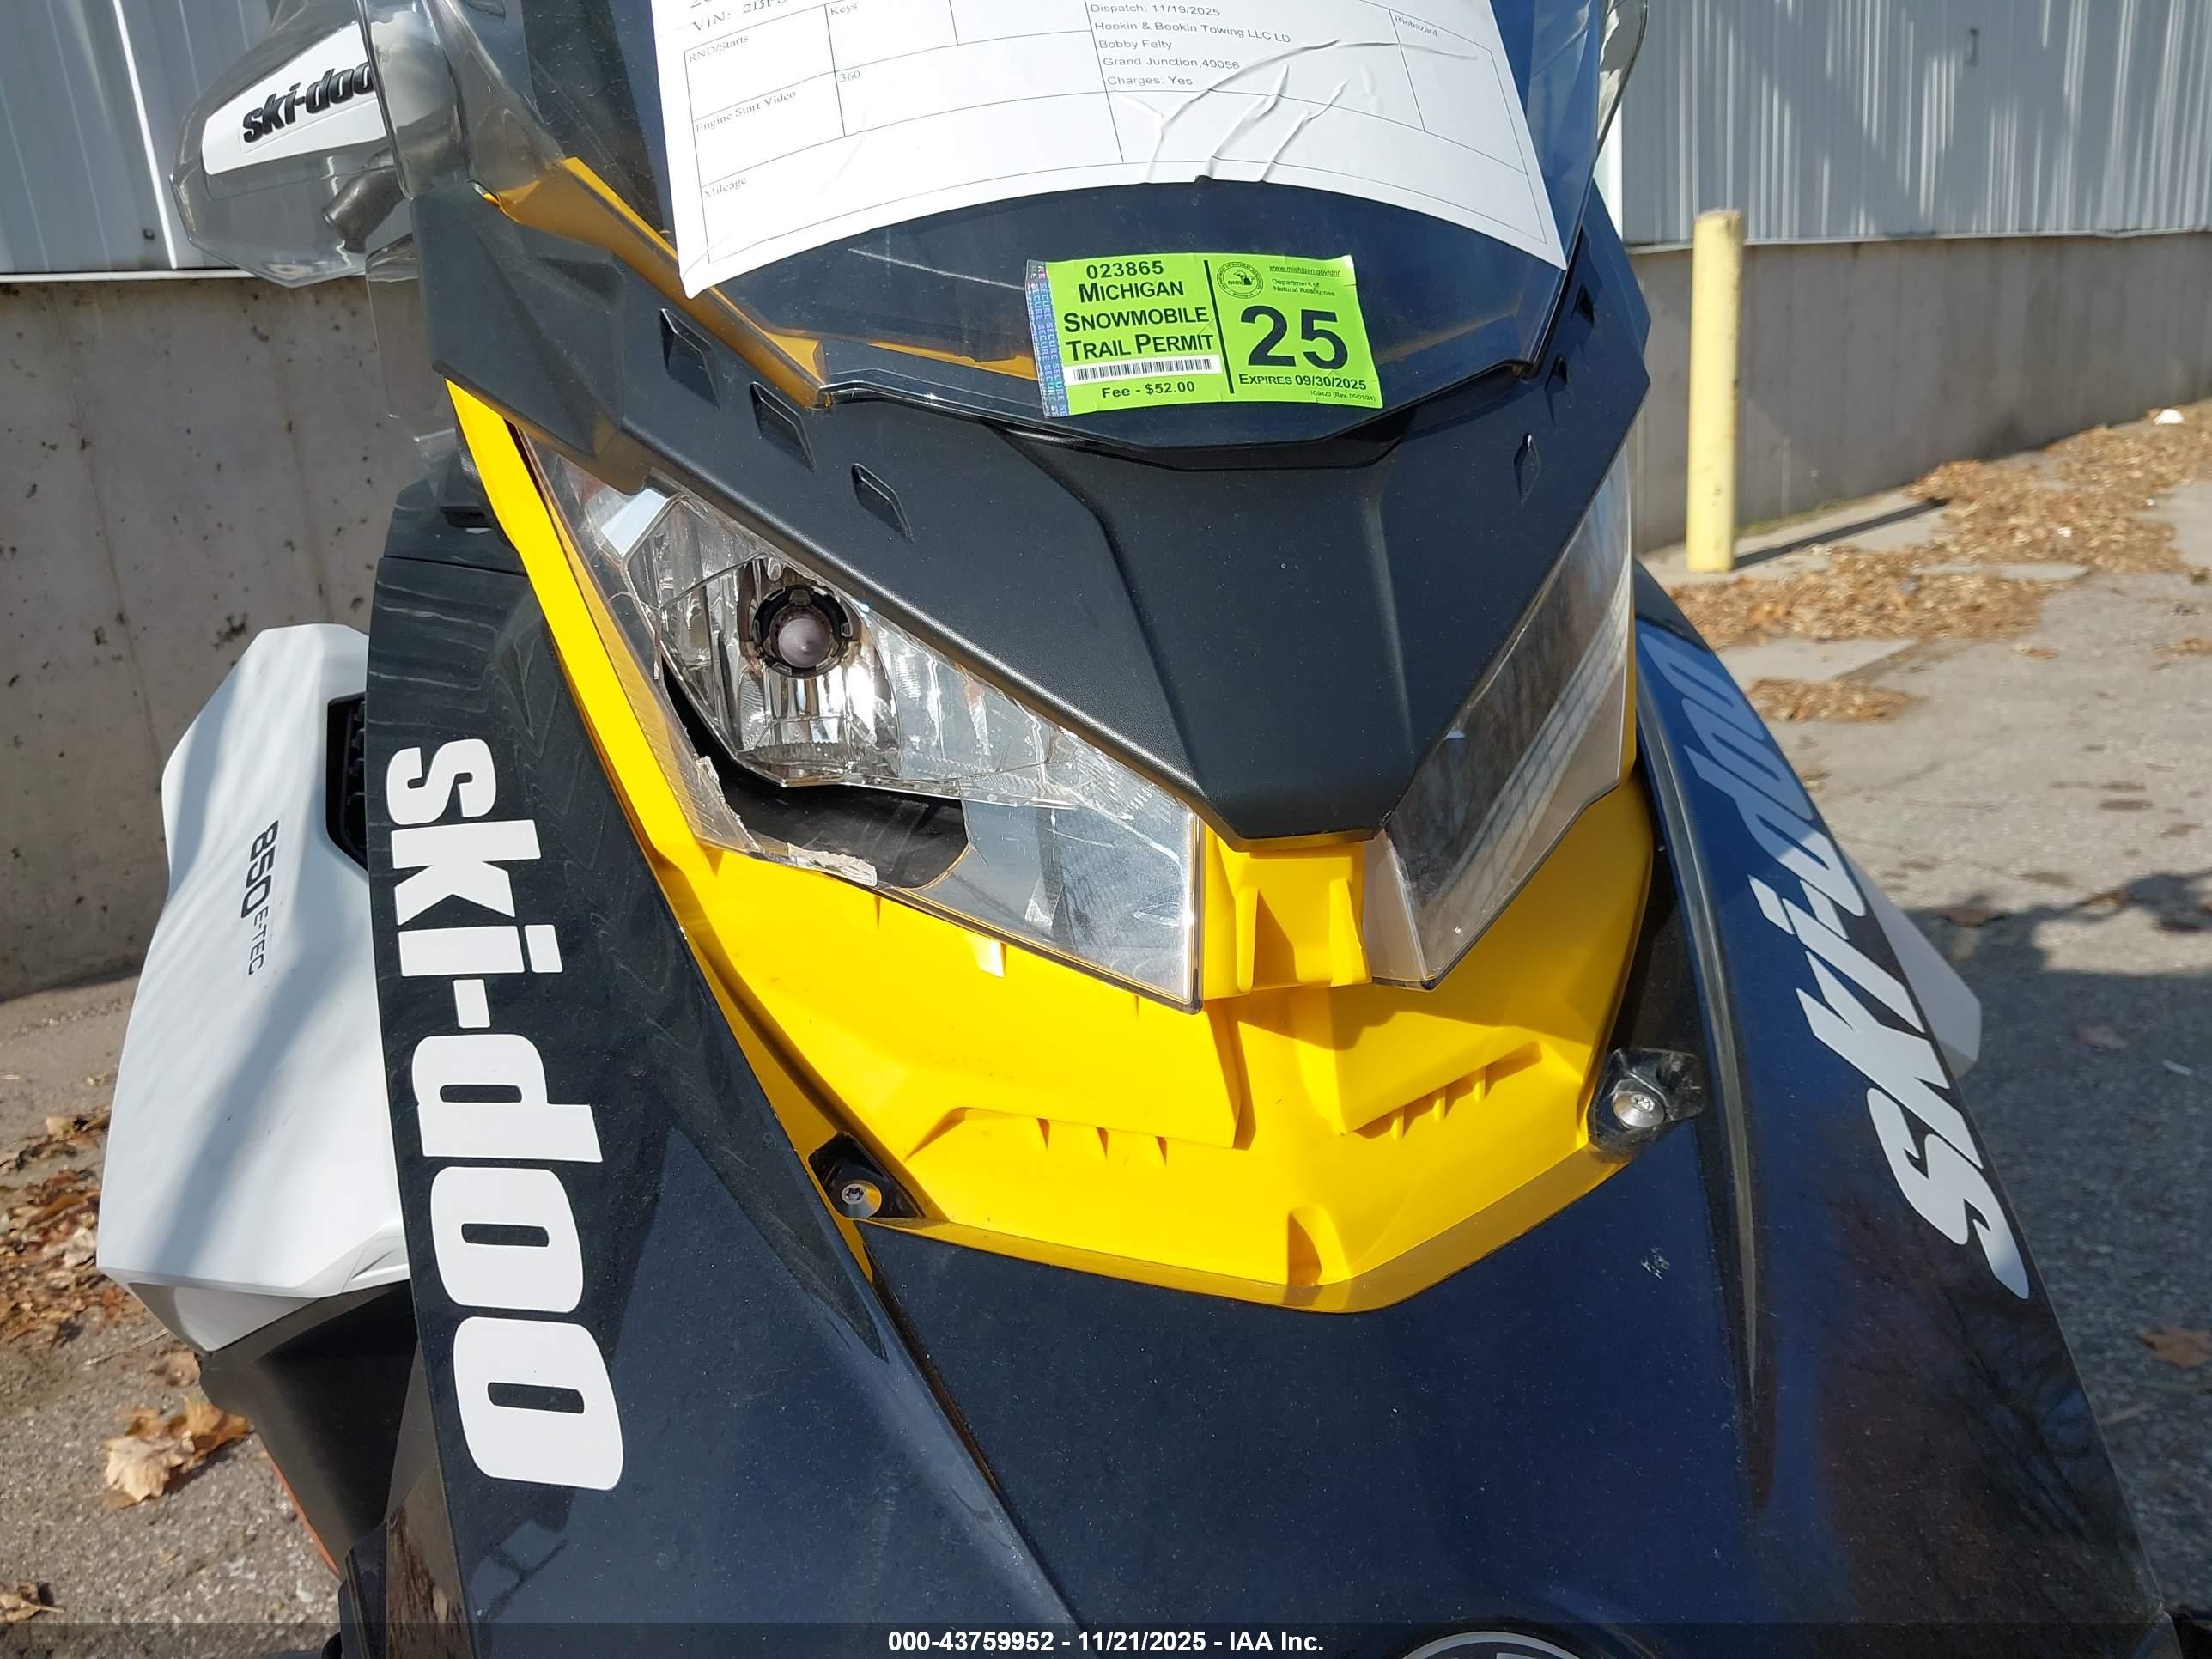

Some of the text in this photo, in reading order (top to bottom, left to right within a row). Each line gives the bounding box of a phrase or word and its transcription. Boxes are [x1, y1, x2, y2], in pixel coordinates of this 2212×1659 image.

[830, 3, 858, 15] Keys
[1091, 4, 1220, 16] Dispatch: 11/19/2025
[692, 11, 731, 31] VIN:
[1394, 15, 1438, 37] Biohazard
[1095, 22, 1137, 31] Hookin
[1155, 22, 1197, 33] Bookin
[1200, 24, 1244, 38] Towing
[1248, 29, 1271, 40] LLC
[1275, 33, 1291, 43] LD
[689, 35, 750, 63] RND/Starts
[1099, 40, 1172, 50] Bobby Felty
[1103, 58, 1240, 70] Grand Junction,49056
[839, 70, 861, 82] 360
[1108, 76, 1193, 86] Charges: Yes
[696, 90, 796, 132] Engine Start Video
[704, 177, 748, 198] Mileage
[1086, 260, 1164, 280] 023865
[1079, 281, 1184, 303] MICHIGAN
[1300, 288, 1335, 296] Resources
[1064, 307, 1209, 333] SNOWMOBILE
[1241, 305, 1348, 369] 25
[1066, 333, 1213, 362] TRAIL PERMIT
[1102, 387, 1130, 399] Fee
[1146, 380, 1195, 395] $52.00
[1239, 374, 1367, 390] EXPIRES 09/30/2025
[241, 820, 279, 975] 850 E-TEC
[386, 738, 623, 1490] ski-doo
